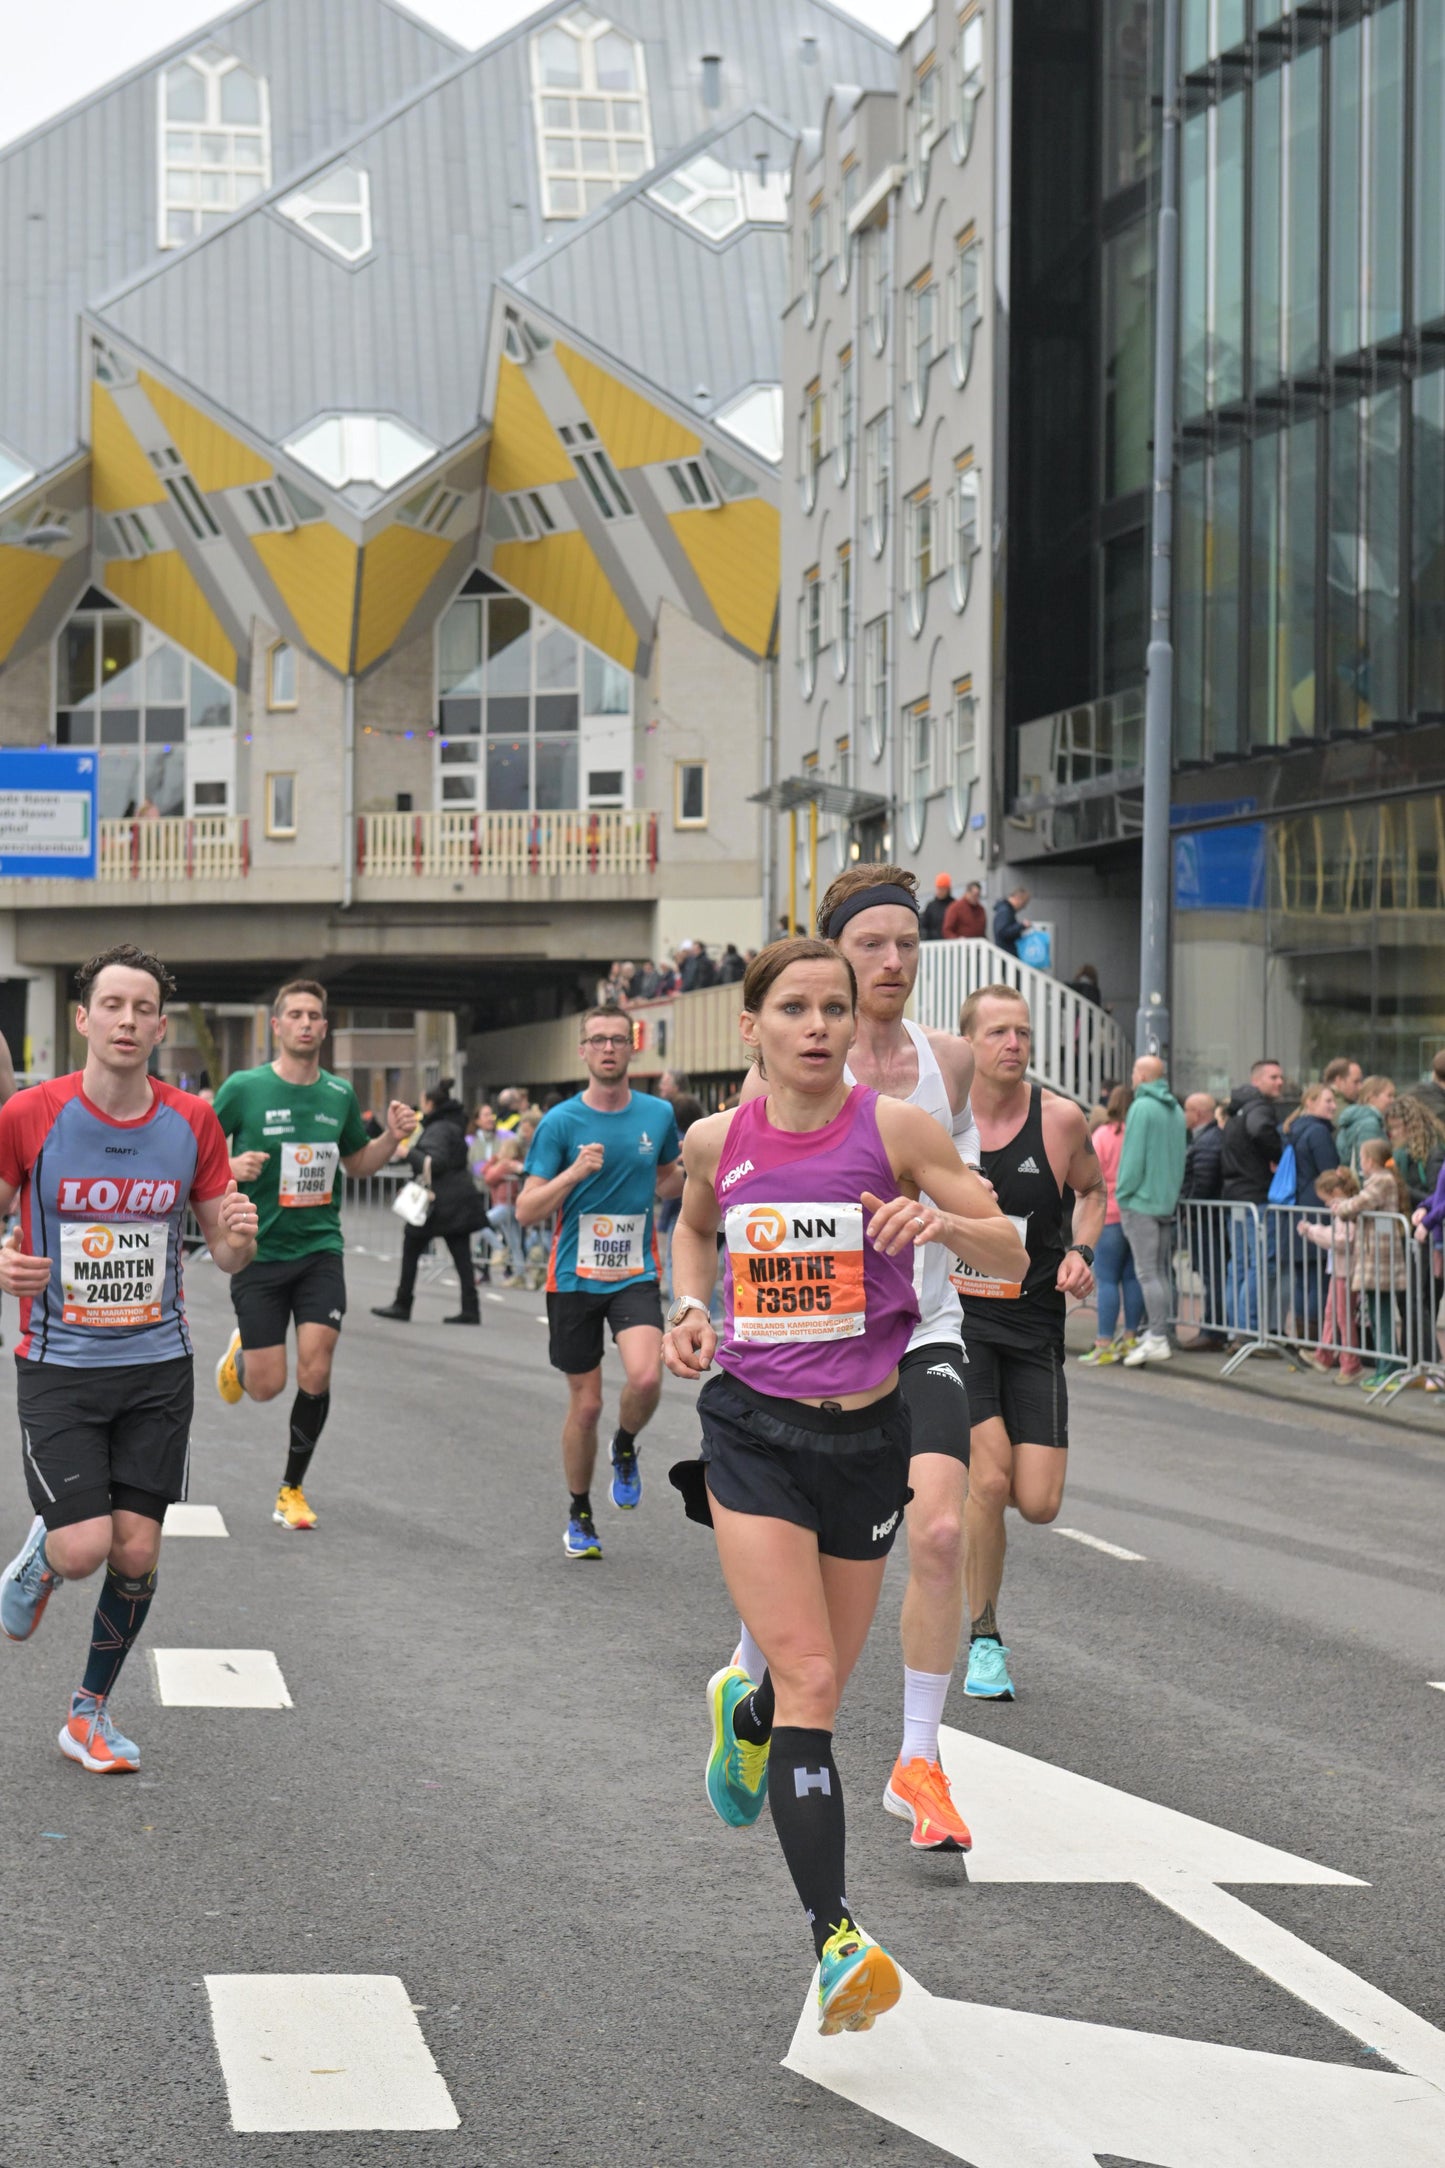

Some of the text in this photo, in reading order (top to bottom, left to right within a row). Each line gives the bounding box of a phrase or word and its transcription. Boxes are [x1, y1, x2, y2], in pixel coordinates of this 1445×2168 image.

[105, 1146, 132, 1155] CRAFT
[315, 1151, 333, 1160] NN
[299, 1166, 325, 1178] JORIS
[721, 1160, 755, 1192] HOKA
[1017, 1166, 1040, 1174] adidas
[296, 1180, 325, 1193] 17496
[616, 1223, 635, 1233] NN
[792, 1218, 836, 1239] NN
[118, 1233, 149, 1249] NN
[593, 1239, 631, 1253] ROGER
[595, 1253, 629, 1268] 17821
[74, 1258, 154, 1280] MAARTEN
[749, 1255, 836, 1283] MIRTHE
[963, 1280, 1000, 1291] MARATHON
[86, 1282, 145, 1303] 24024
[757, 1285, 831, 1314] F3505
[101, 1308, 144, 1317] MARATHON
[81, 1316, 128, 1324] ROTTERDAM
[741, 1317, 854, 1330] NEDERLANDS KAMPIOENSCHAP
[751, 1329, 787, 1337] MARATHON
[790, 1327, 834, 1336] ROTTERDAM
